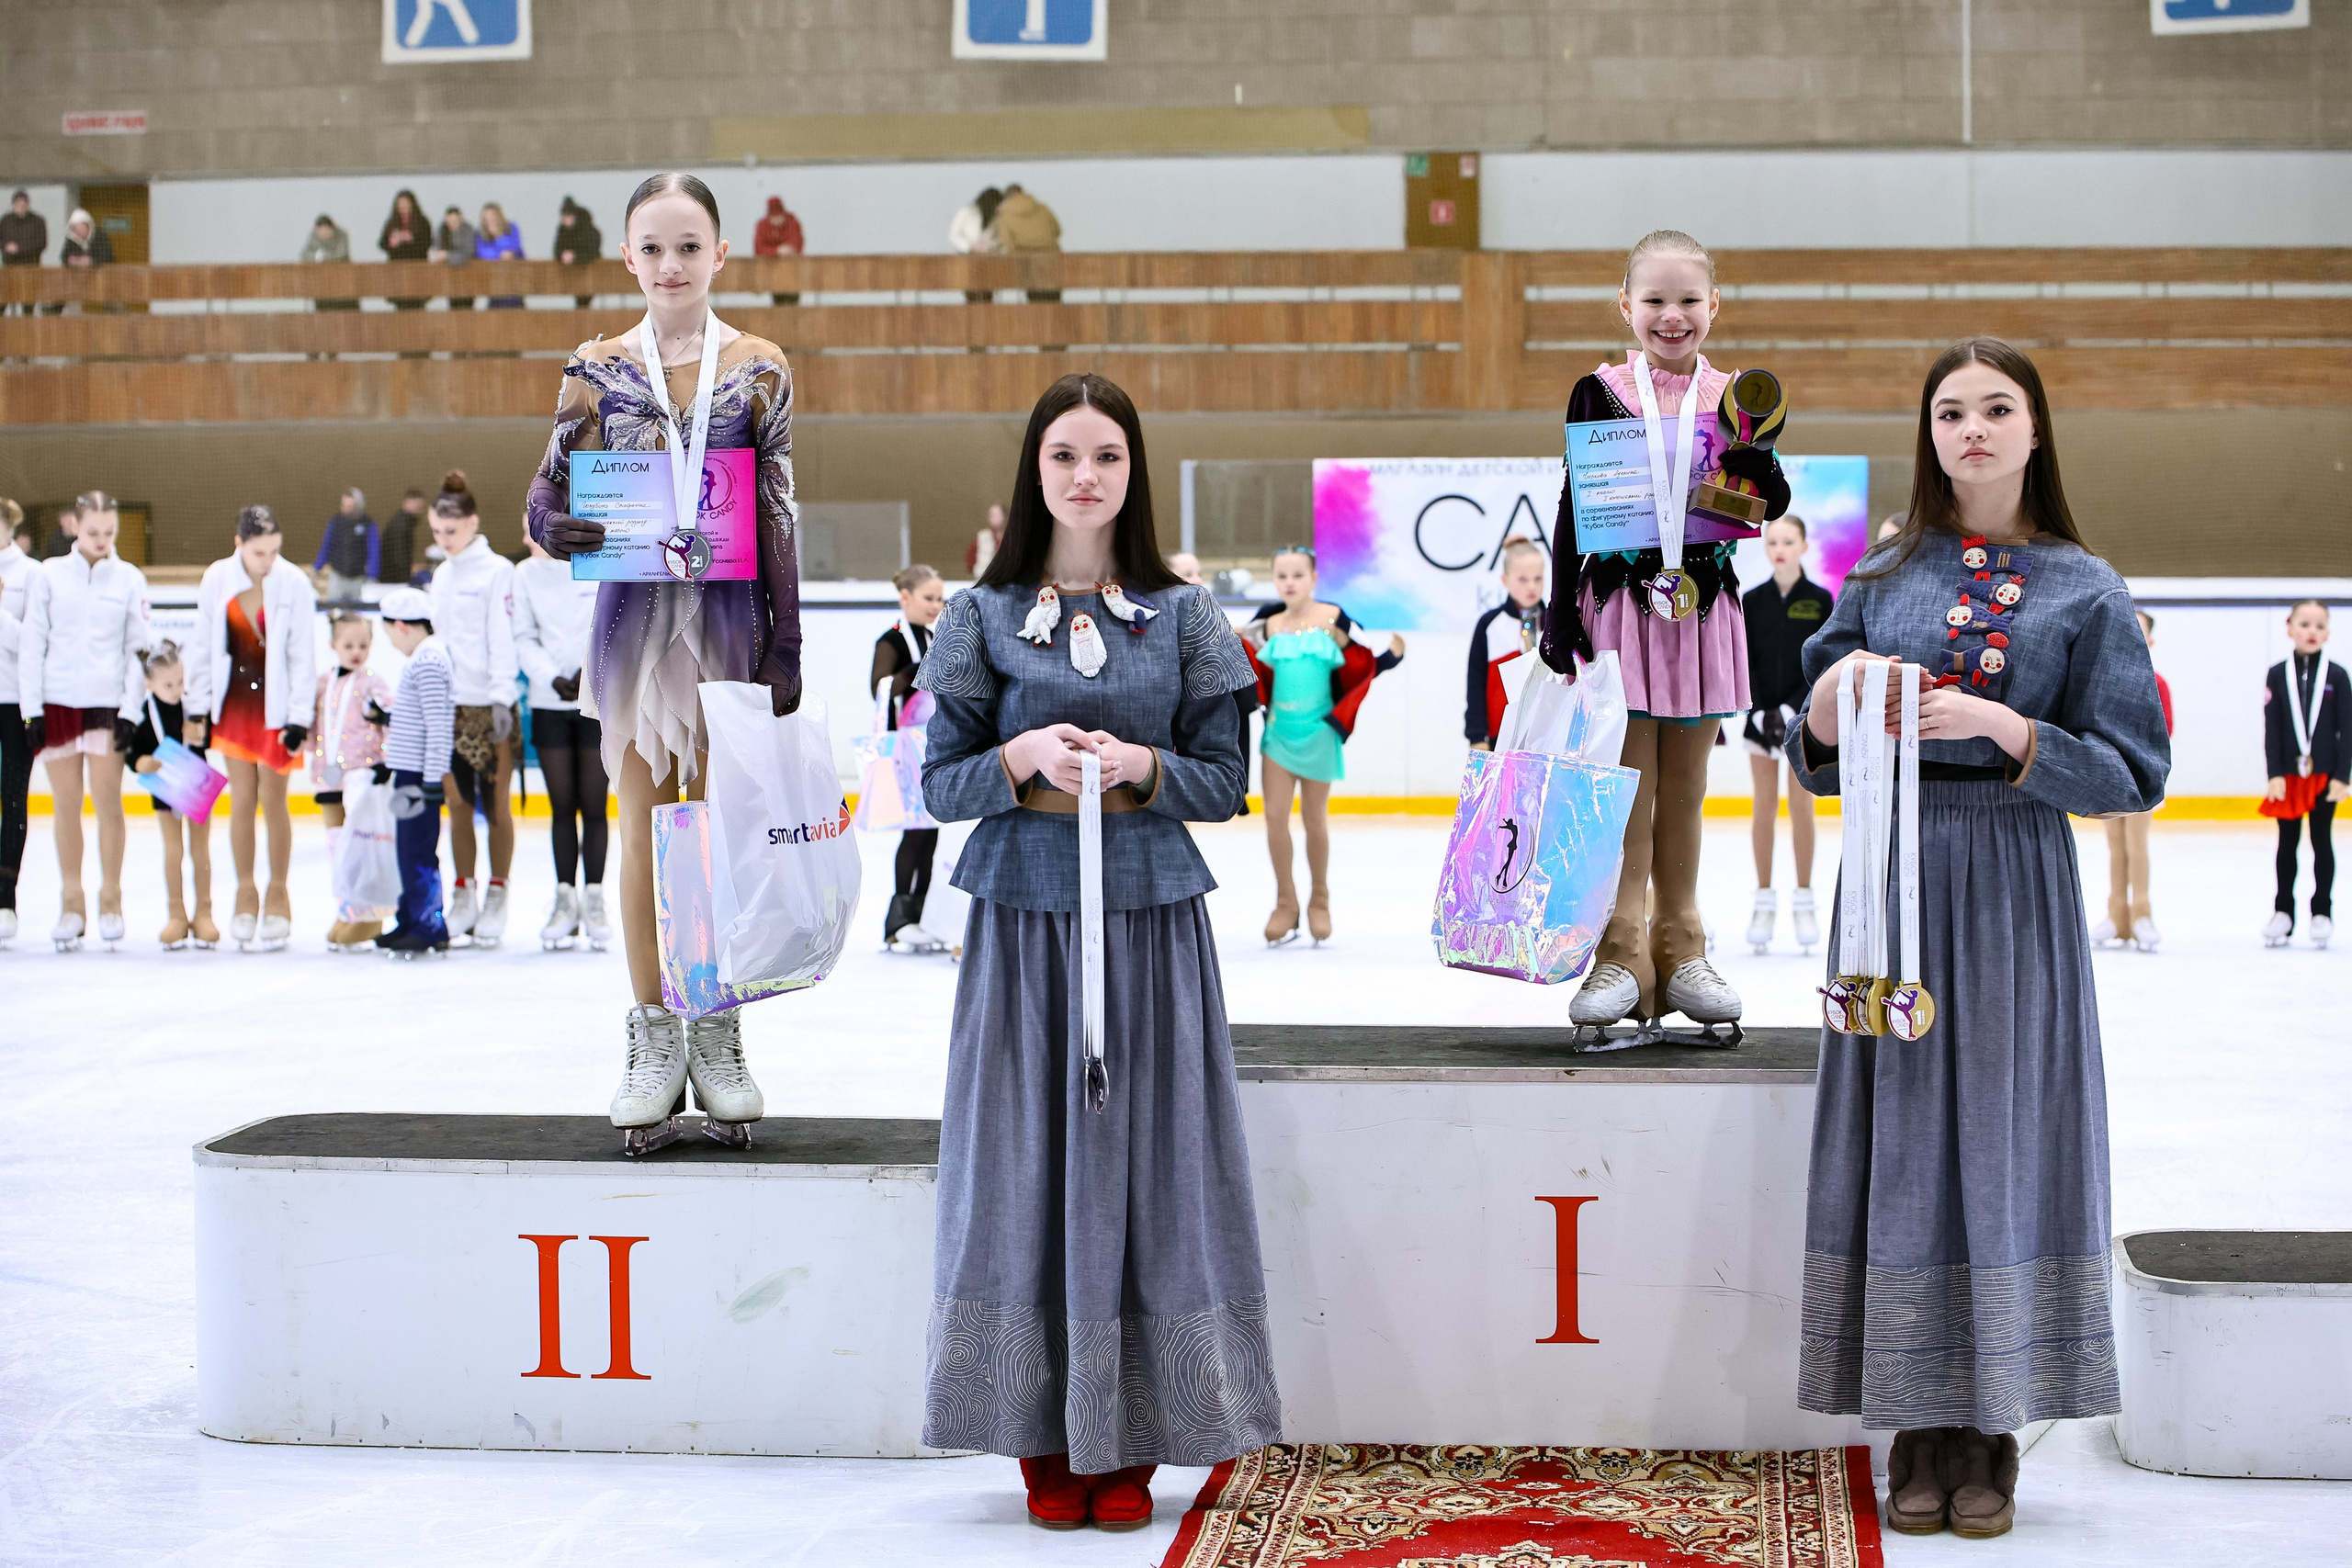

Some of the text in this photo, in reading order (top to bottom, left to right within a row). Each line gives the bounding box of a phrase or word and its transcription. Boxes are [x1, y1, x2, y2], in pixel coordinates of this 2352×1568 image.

[1577, 461, 1623, 470] Награждается
[1661, 480, 1669, 502] КУБОК
[1586, 505, 1634, 514] соревнованиях
[1590, 513, 1626, 522] фигурному
[768, 818, 836, 845] smartavia
[1534, 1196, 1600, 1343] I
[518, 1235, 652, 1380] II
